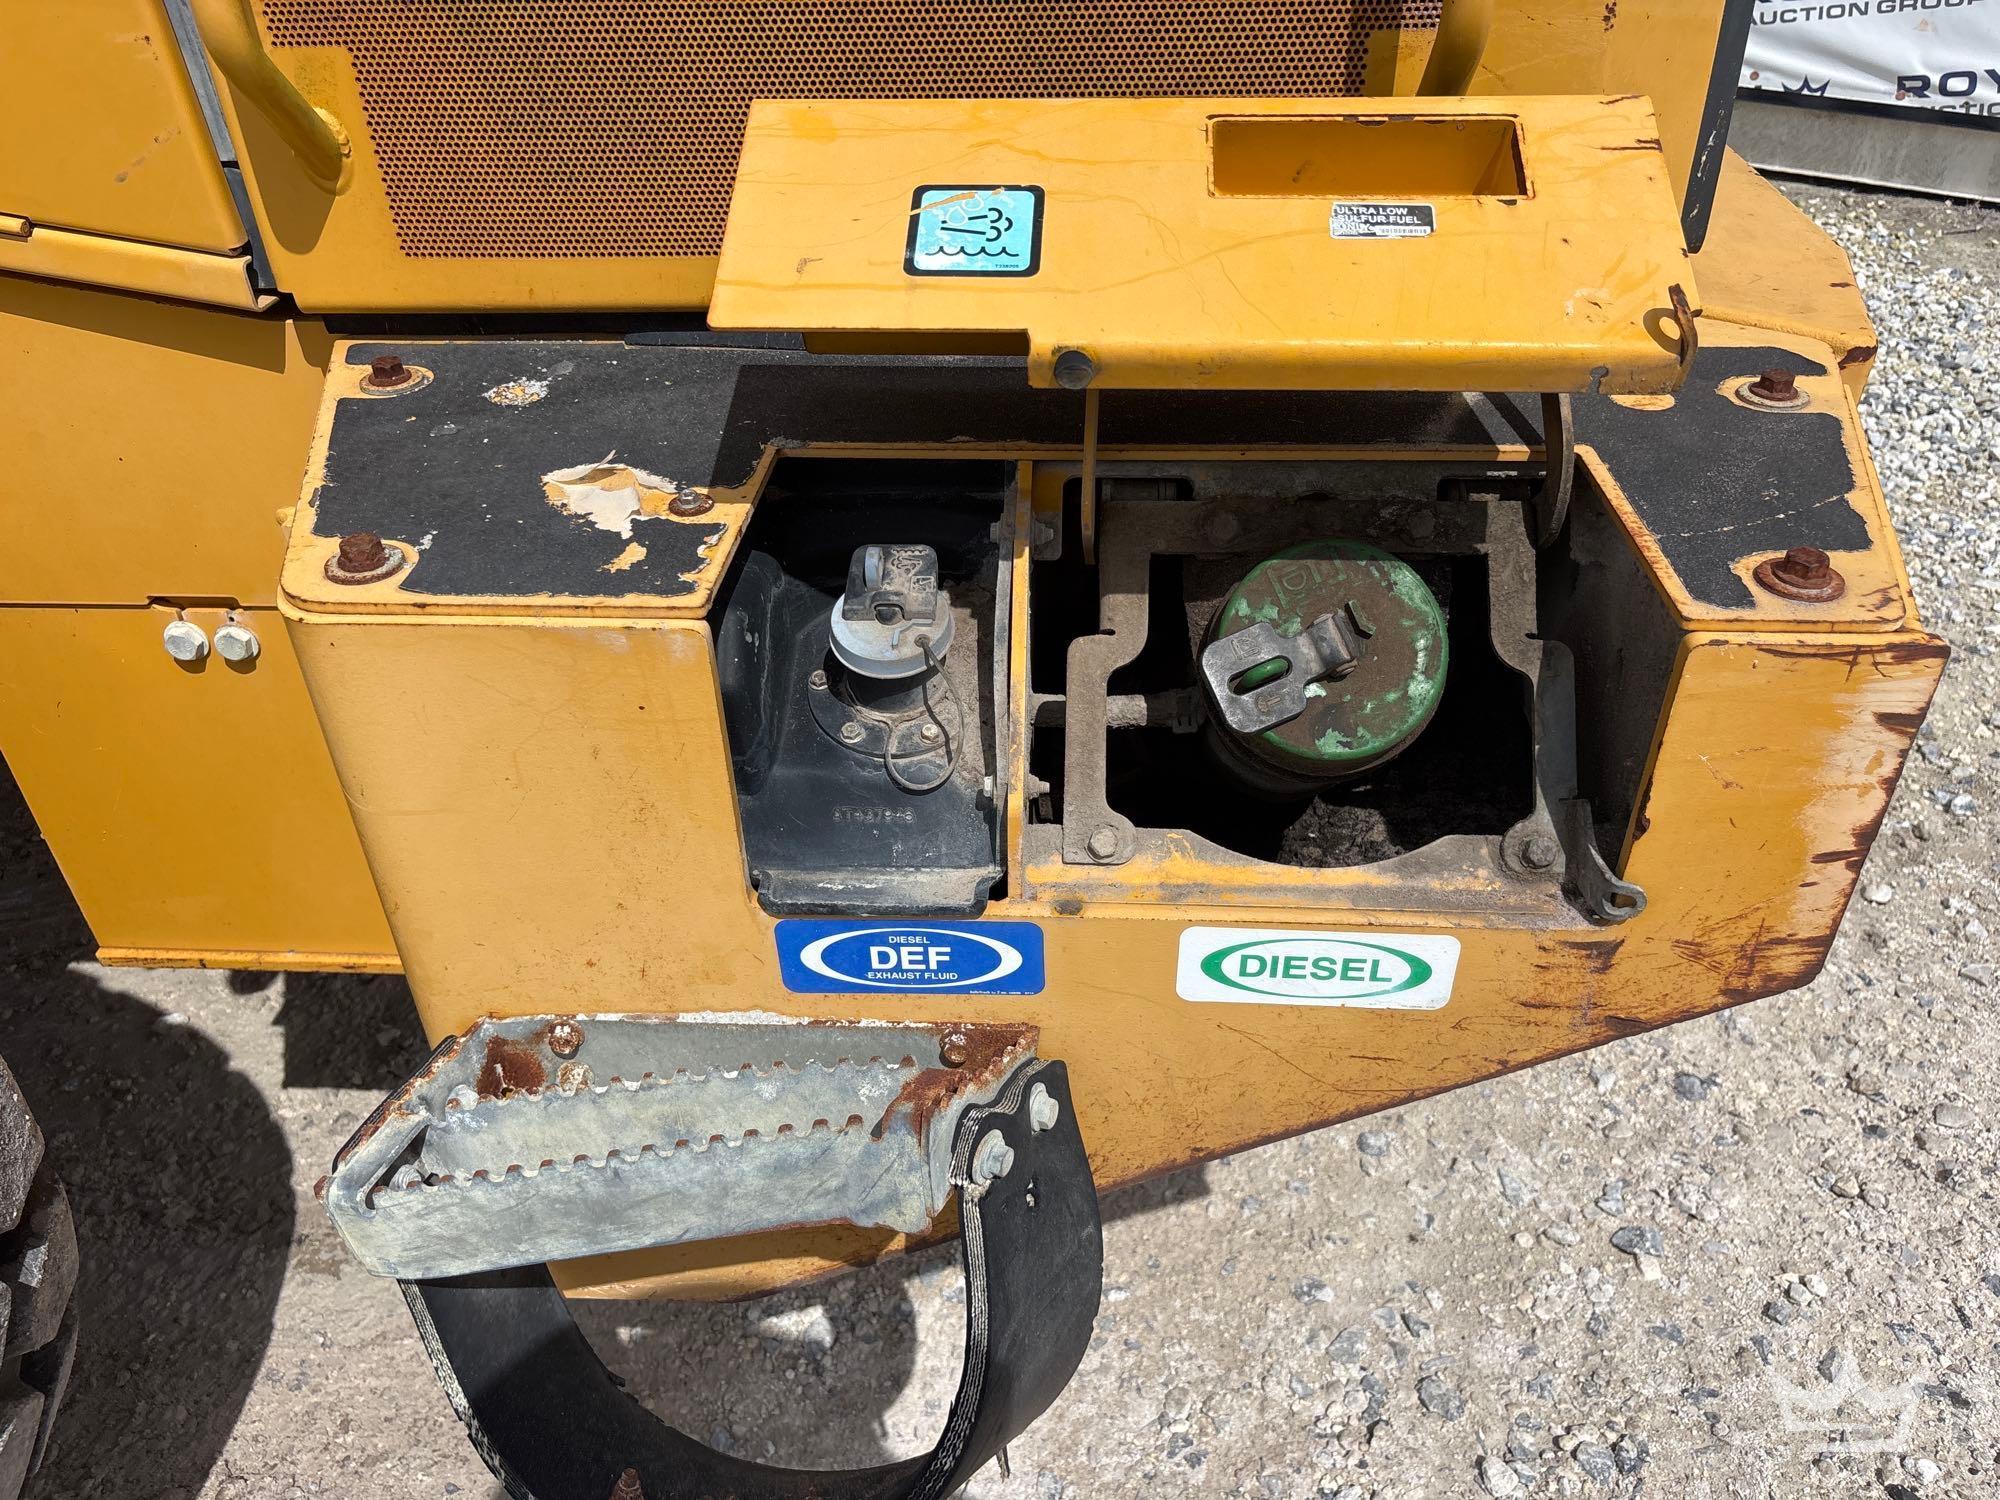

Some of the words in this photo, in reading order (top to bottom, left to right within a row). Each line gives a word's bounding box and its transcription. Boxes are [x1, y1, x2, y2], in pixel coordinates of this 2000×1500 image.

[1336, 206, 1378, 215] ULTRA
[1379, 207, 1408, 215] LOW
[1337, 214, 1388, 223] SULFUR
[1390, 215, 1422, 224] FUEL
[888, 935, 931, 944] DIESEL
[869, 945, 953, 970] DEF
[1238, 954, 1393, 983] DIESEL
[867, 971, 921, 980] EXHAUST
[924, 971, 959, 980] FLUID
